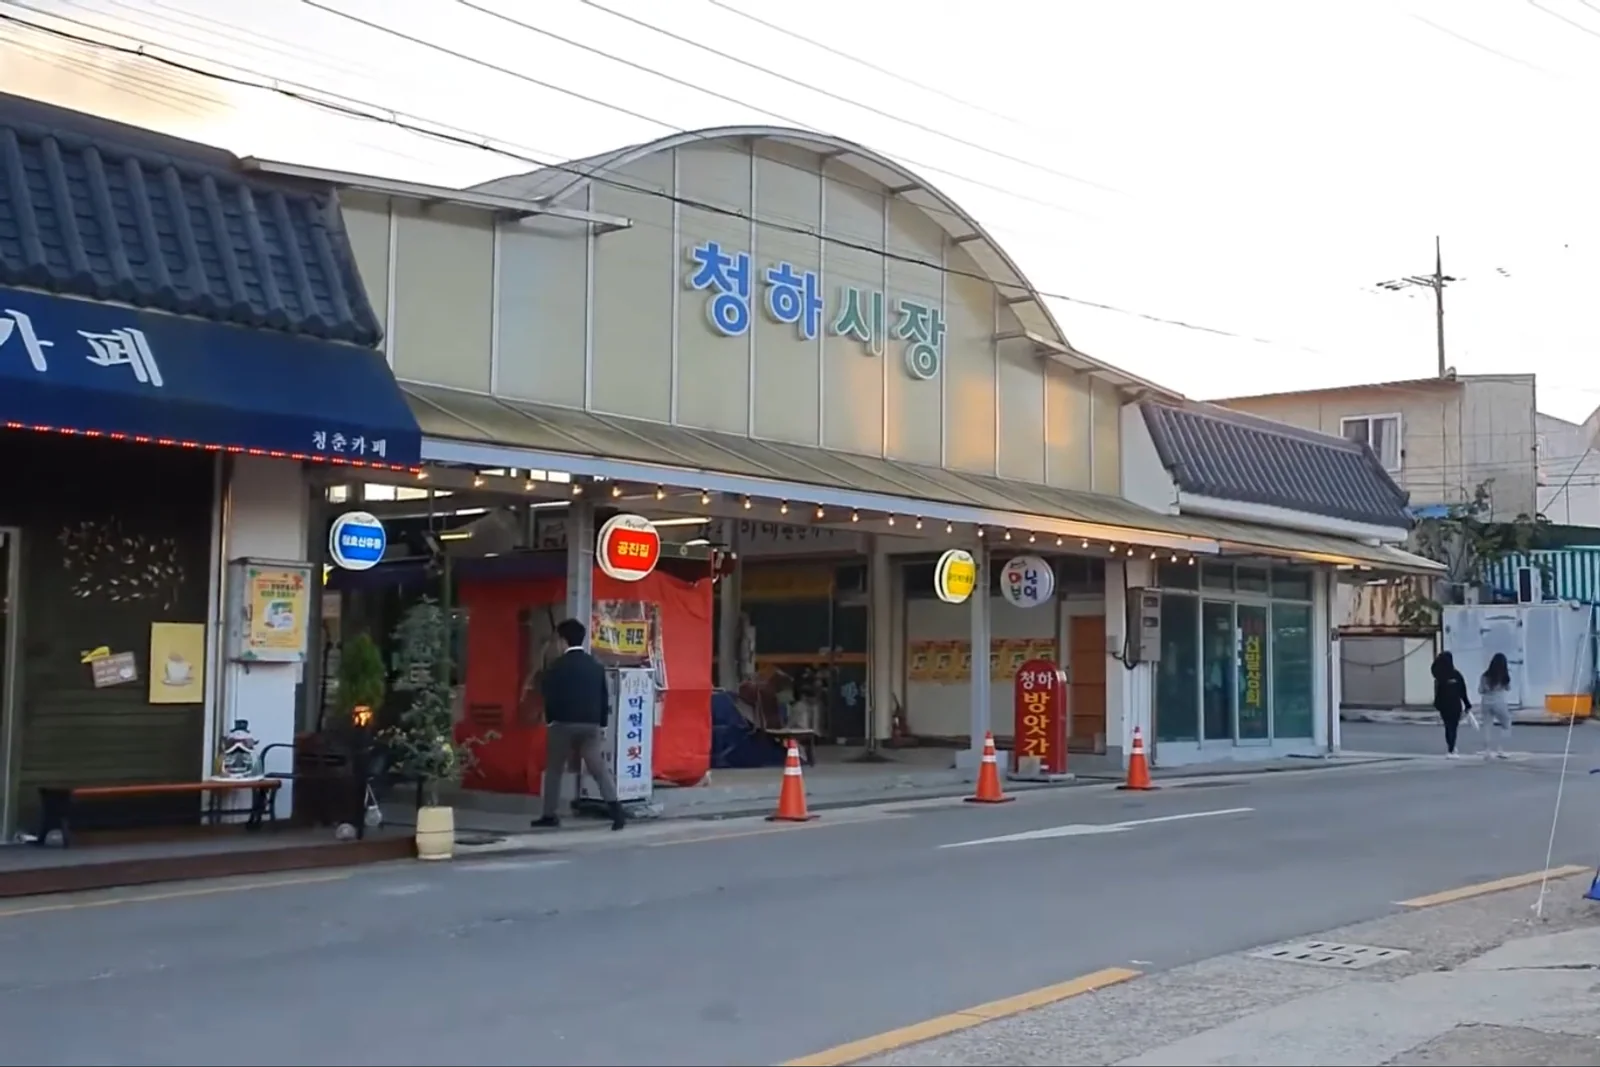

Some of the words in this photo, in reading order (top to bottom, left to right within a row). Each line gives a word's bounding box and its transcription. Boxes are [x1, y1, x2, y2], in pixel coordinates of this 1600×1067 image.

[690, 240, 948, 380] 청하시장
[312, 431, 387, 458] 청춘카페
[617, 541, 650, 559] 공진집
[1020, 671, 1053, 690] 청하
[1023, 692, 1050, 759] 방앗간
